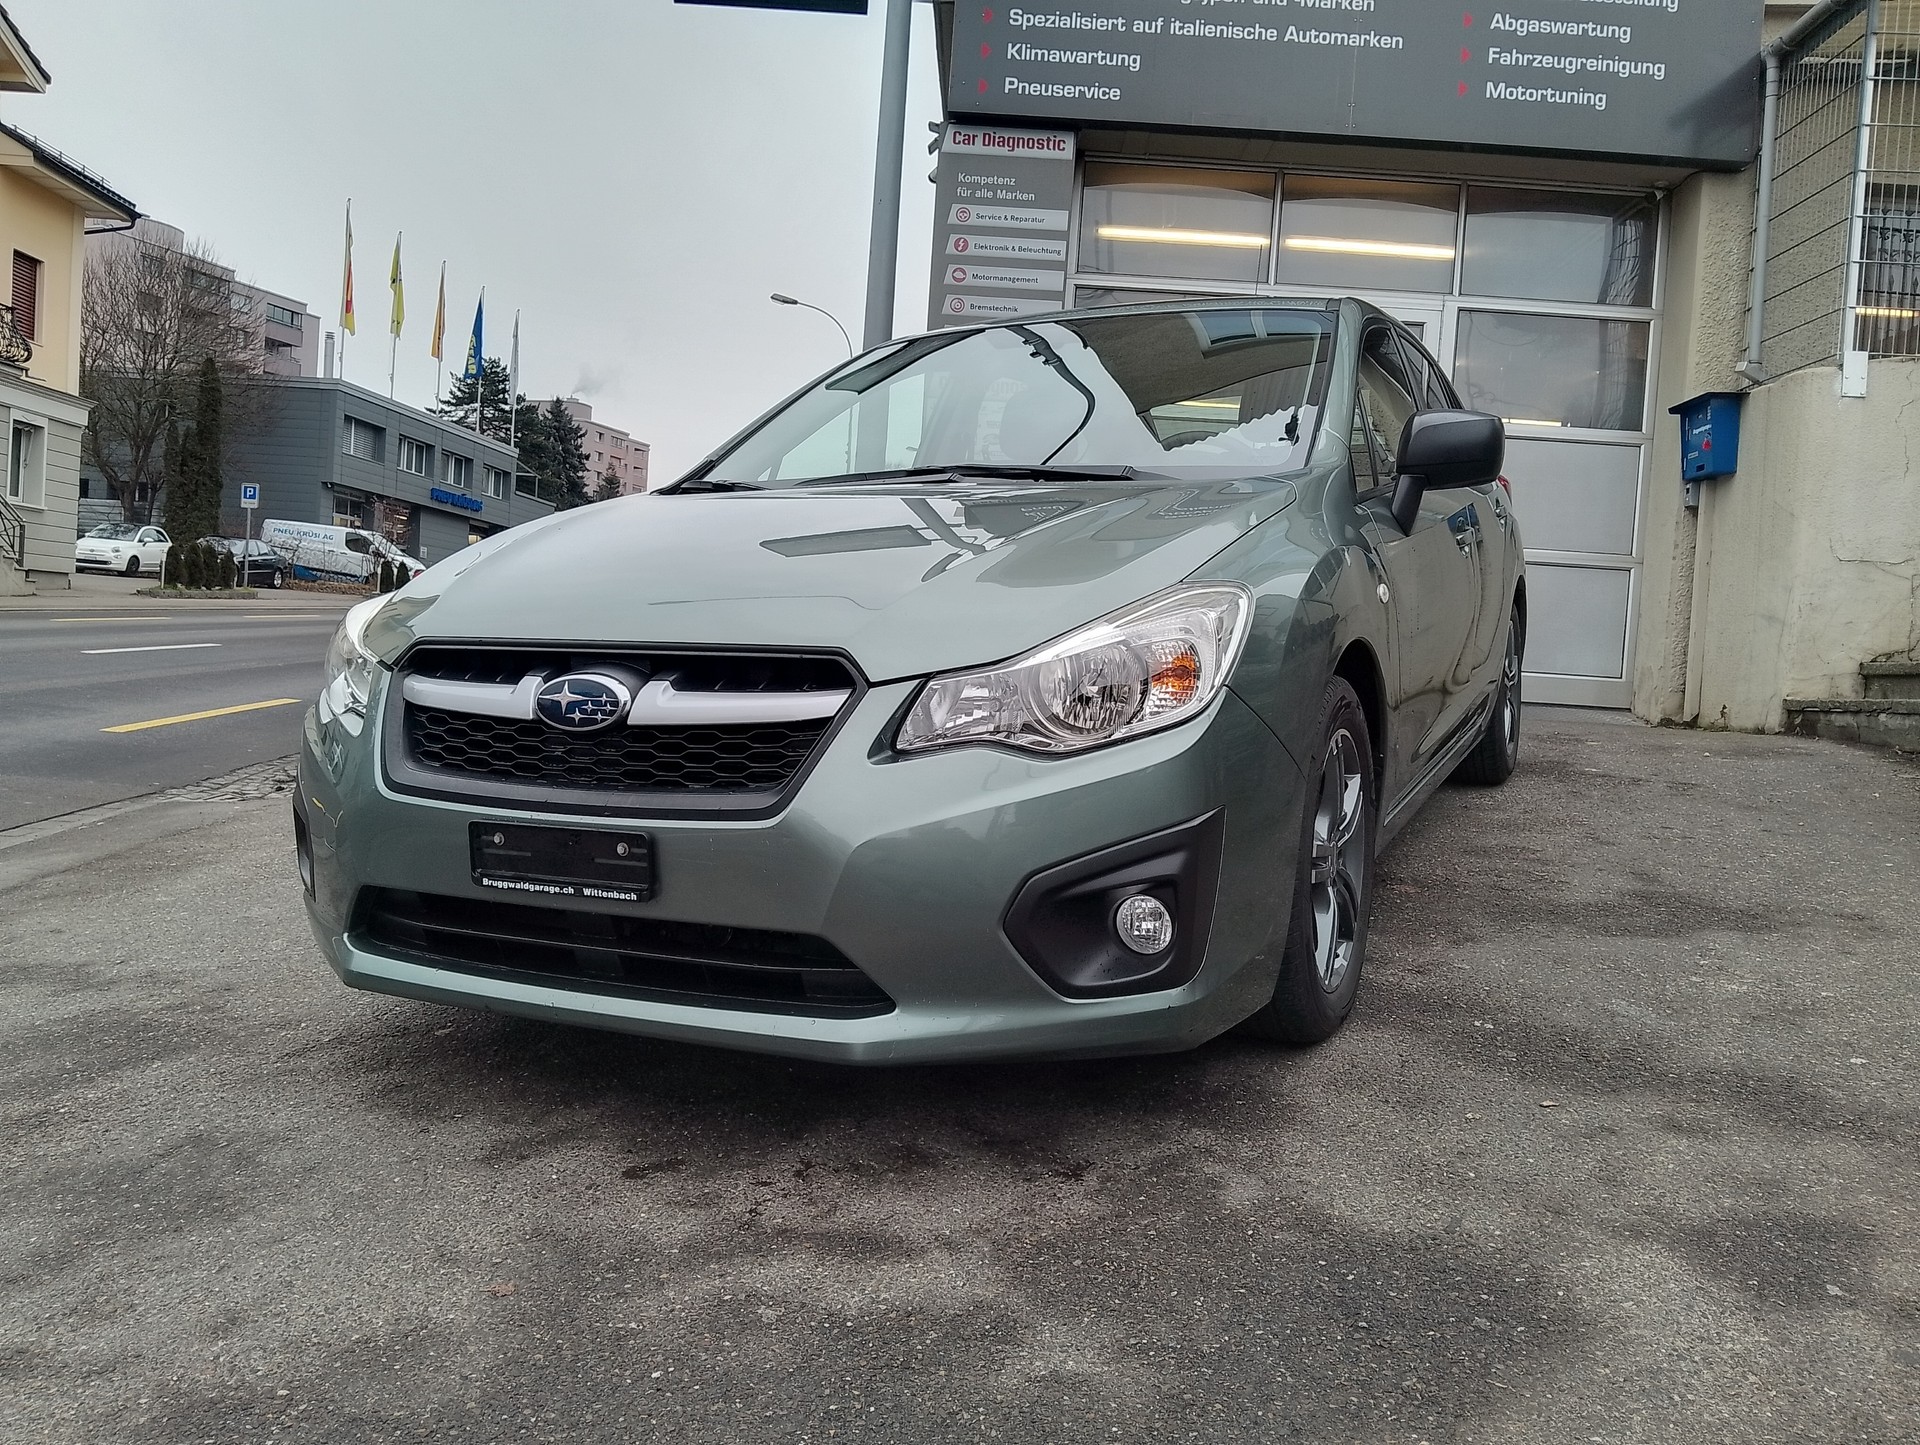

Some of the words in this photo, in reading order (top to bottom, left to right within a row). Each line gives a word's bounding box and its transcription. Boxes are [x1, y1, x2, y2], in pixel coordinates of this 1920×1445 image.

[1009, 9, 1126, 33] Spezialisiert
[1132, 17, 1164, 35] auf
[1169, 18, 1278, 42] italienische
[1284, 26, 1404, 50] Automarken
[1490, 12, 1631, 43] Abgaswartung
[1006, 43, 1141, 71] Klimawartung
[1488, 47, 1665, 80] Fahrzeugreinigung
[1004, 77, 1121, 101] Pneuservice
[1486, 82, 1606, 110] Motortuning
[952, 130, 978, 146] Car
[982, 131, 1066, 152] Diagnostic
[958, 172, 1016, 186] Kompetenz
[957, 187, 972, 197] für
[975, 188, 993, 199] alle
[997, 190, 1035, 201] Marken
[975, 212, 1002, 221] Service
[1004, 213, 1009, 221] &
[1010, 214, 1045, 224] Reparatur
[974, 242, 1010, 252] Elektronik
[1018, 245, 1062, 256] Beleuchtung
[972, 273, 1039, 284] Motormanagement
[970, 303, 1018, 313] Bremstechnik
[247, 487, 254, 499] P
[273, 528, 294, 536] PNEU
[482, 877, 574, 894] Bruggwaldgarage.ch
[583, 887, 637, 901] Wittenbach
